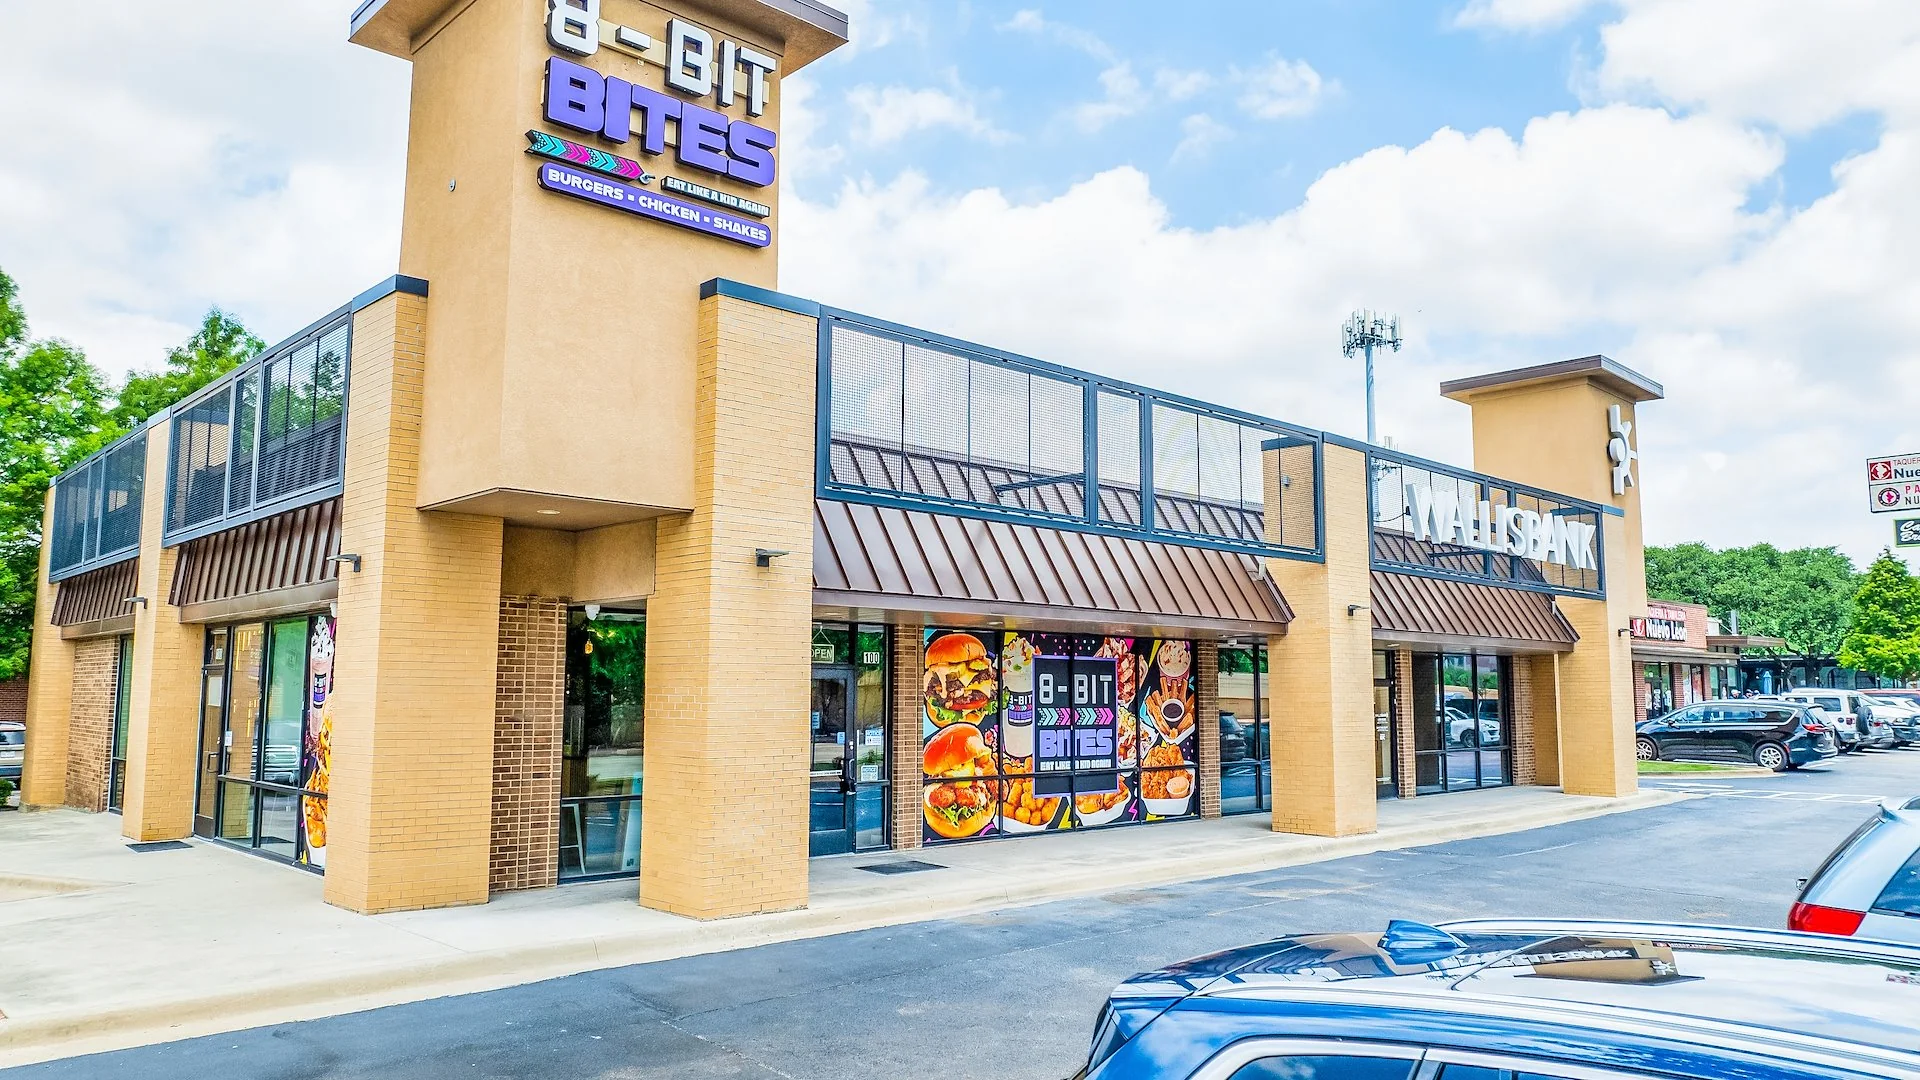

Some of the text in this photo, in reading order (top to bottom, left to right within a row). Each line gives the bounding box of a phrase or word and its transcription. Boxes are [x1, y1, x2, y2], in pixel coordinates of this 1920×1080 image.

[544, 56, 776, 188] BITES
[548, 168, 767, 241] BURGERS CHICKEN SHAKES
[667, 177, 769, 216] EAT LIKE A KID AGAIN
[1646, 619, 1670, 639] Nuevo
[865, 652, 879, 664] 100
[1039, 673, 1112, 704] 8-BIT
[1040, 729, 1112, 757] BITES
